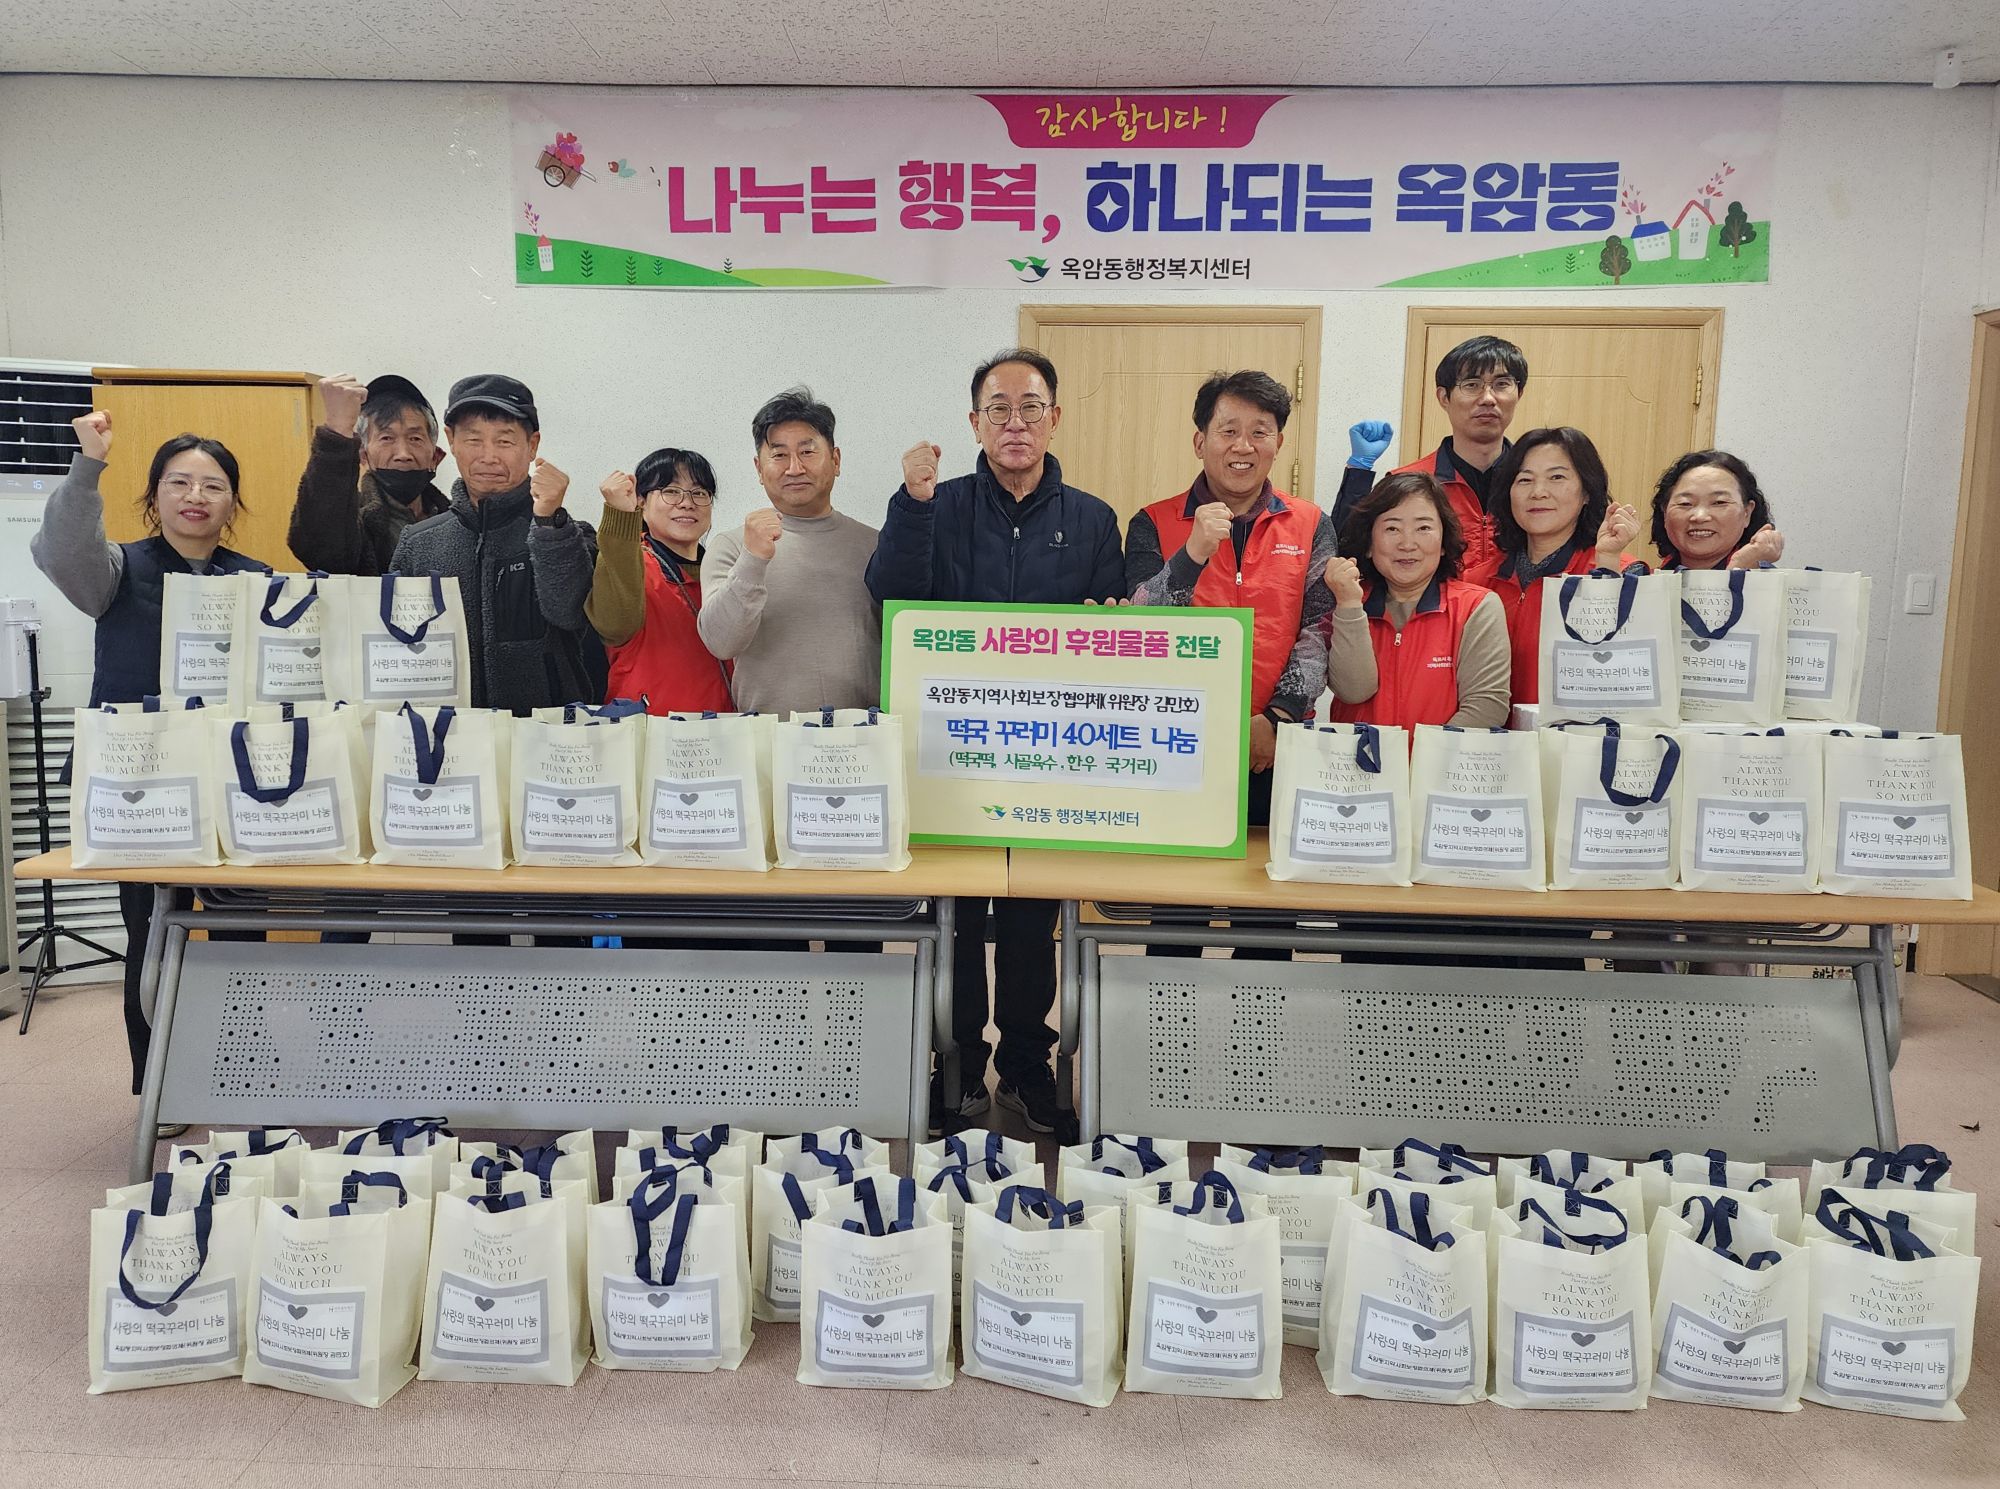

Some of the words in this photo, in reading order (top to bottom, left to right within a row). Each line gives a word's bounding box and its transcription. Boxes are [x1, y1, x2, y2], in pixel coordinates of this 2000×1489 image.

[669, 166, 876, 234] 나누는
[899, 160, 1061, 242] 행복,
[1085, 162, 1374, 232] 하나되는
[1396, 162, 1619, 232] 옥암동
[1059, 257, 1250, 281] 옥암동행정복지센터
[510, 563, 525, 571] K2
[913, 628, 976, 652] 옥암동
[981, 628, 1058, 655] 사랑의
[1065, 629, 1169, 658] 후원물품
[1176, 636, 1221, 659] 전달
[926, 686, 1150, 712] 옥암동지역사회보장협의체(위원장
[1154, 695, 1200, 713] 김민호)
[947, 719, 990, 745] 떡국
[995, 721, 1057, 747] 꾸러미
[1062, 722, 1141, 749] 40세트
[1152, 728, 1198, 754] 나눔
[1105, 757, 1157, 775] 국거리)
[1011, 807, 1052, 823] 옥암동
[1057, 809, 1139, 827] 행정복지센터
[144, 1244, 197, 1257] ALWAYS
[280, 1250, 328, 1263] ALWAYS
[463, 1249, 492, 1268] THANK
[498, 1255, 527, 1269] YOU
[1185, 1251, 1234, 1268] ALWAYS
[131, 1258, 173, 1271] THANK
[274, 1257, 306, 1276] THANK
[312, 1263, 343, 1276] YOU
[467, 1265, 479, 1275] SO
[482, 1270, 518, 1281] MUCH
[849, 1264, 901, 1276] ALWAYS
[990, 1264, 1032, 1284] THANK
[1036, 1274, 1064, 1284] YOU
[1000, 1258, 1050, 1272] ALWAYS
[1172, 1260, 1216, 1280] THANK
[1223, 1269, 1247, 1281] YOU
[138, 1272, 154, 1283] SO
[290, 1278, 331, 1289] MUCH
[836, 1273, 882, 1289] THANK
[887, 1273, 913, 1286] YOU
[1180, 1275, 1195, 1288] SO
[1200, 1282, 1239, 1294] MUCH
[1402, 1271, 1452, 1293] ALWAYS
[844, 1288, 860, 1298] SO
[865, 1287, 904, 1301] MUCH
[996, 1280, 1011, 1291] SO
[1014, 1286, 1055, 1296] MUCH
[1386, 1277, 1434, 1302] THANK
[1558, 1282, 1613, 1296] ALWAYS
[1868, 1287, 1923, 1301] ALWAYS
[1394, 1293, 1411, 1306] SO
[1416, 1301, 1453, 1319] MUCH
[1542, 1292, 1595, 1308] THANK
[1600, 1294, 1620, 1307] YOU
[1702, 1293, 1752, 1319] THANK
[1851, 1294, 1907, 1313] THANK
[1910, 1303, 1935, 1313] YOU
[442, 1309, 464, 1326] 사랑의
[467, 1314, 513, 1330] 떡국꾸러미
[518, 1315, 537, 1327] 나눔
[610, 1310, 636, 1325] 사랑의
[640, 1313, 686, 1327] 떡국꾸러미
[690, 1312, 709, 1325] 나눔
[1552, 1306, 1570, 1317] SO
[1576, 1309, 1615, 1320] MUCH
[1709, 1311, 1728, 1324] SO
[1860, 1309, 1879, 1322] SO
[1887, 1315, 1924, 1326] MUCH
[113, 1320, 142, 1334] 사랑의
[146, 1319, 199, 1335] 떡국꾸러미
[204, 1314, 224, 1329] 나눔
[260, 1313, 280, 1331] 사랑의
[282, 1323, 326, 1341] 떡국꾸러미
[330, 1325, 351, 1340] 나눔
[978, 1316, 1001, 1336] 사랑의
[1004, 1327, 1050, 1347] 떡국꾸러미
[1053, 1336, 1073, 1350] 나눔
[1155, 1319, 1184, 1337] 사랑의
[1188, 1326, 1235, 1343] 떡국꾸러미
[1238, 1328, 1255, 1342] 나눔
[824, 1325, 851, 1342] 사랑의
[855, 1332, 902, 1345] 떡국꾸러미
[906, 1329, 925, 1341] 나눔
[1366, 1331, 1398, 1351] 사랑의
[1402, 1341, 1451, 1360] 떡국꾸러미
[1455, 1343, 1470, 1357] 나눔
[1525, 1344, 1557, 1360] 사랑의
[1563, 1350, 1611, 1363] 떡국꾸러미
[1615, 1347, 1630, 1360] 나눔
[1675, 1338, 1706, 1360] 사랑의
[1712, 1352, 1761, 1368] 떡국꾸러미
[1764, 1353, 1781, 1365] 나눔
[1831, 1349, 1866, 1367] 사랑의
[1872, 1357, 1924, 1374] 떡국꾸러미
[1928, 1361, 1945, 1374] 나눔
